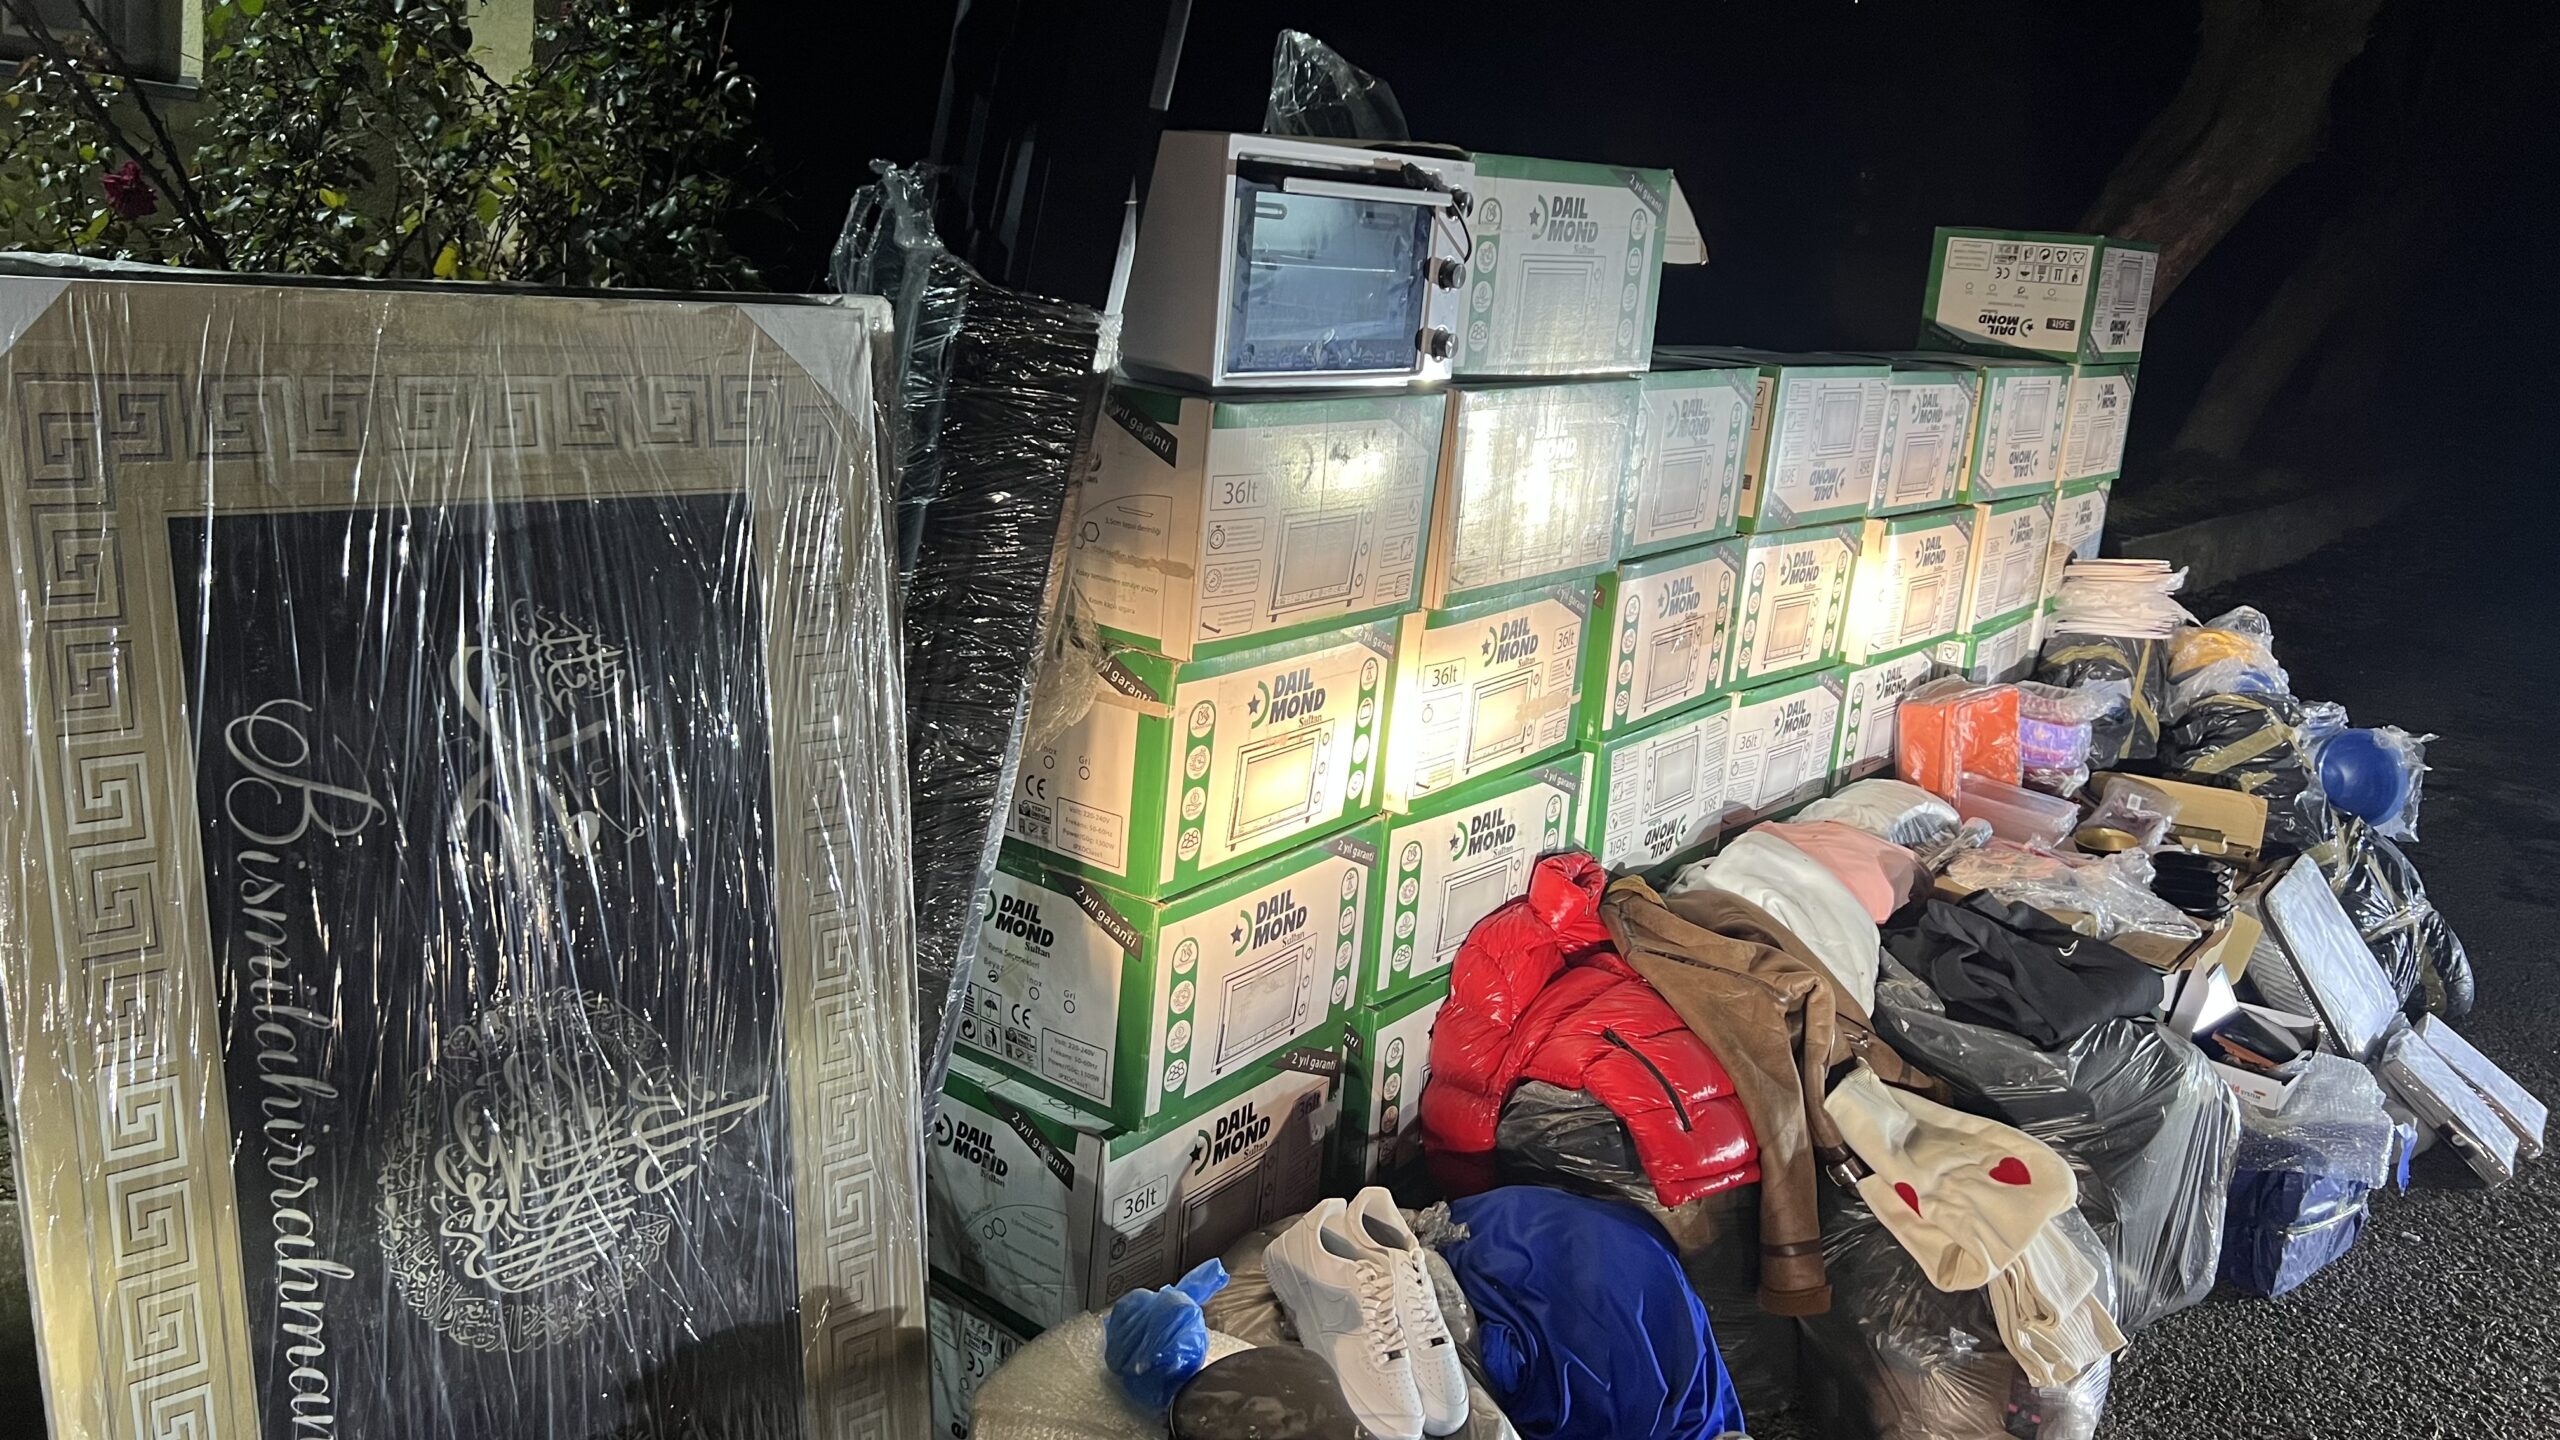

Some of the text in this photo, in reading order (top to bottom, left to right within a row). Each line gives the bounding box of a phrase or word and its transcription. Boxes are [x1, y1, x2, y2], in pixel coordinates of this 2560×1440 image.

[1551, 196, 1588, 219] DAIL
[1547, 221, 1599, 243] MOND
[1978, 315, 2020, 326] MOND
[1987, 325, 2017, 336] DAIL
[2052, 320, 2071, 330] 36lt
[1922, 394, 1939, 408] DAIL
[1114, 404, 1128, 424] yıl
[1920, 409, 1943, 424] MOND
[1809, 468, 1838, 486] MOND
[1222, 480, 1259, 505] 36lt
[1814, 486, 1833, 501] DAIL
[1925, 536, 1942, 551] DAIL
[1793, 550, 1815, 568] DAIL
[1922, 550, 1946, 567] MOND
[1671, 576, 1694, 597] DAIL
[1789, 566, 1819, 585] MOND
[1668, 592, 1700, 616] MOND
[1500, 617, 1530, 642] DAIL
[1557, 630, 1575, 651] 36lt
[1497, 635, 1539, 665] MOND
[1273, 667, 1314, 698] DAIL
[1432, 664, 1457, 688] 36lt
[1886, 666, 1902, 682] DAIL
[1884, 679, 1907, 698] MOND
[1269, 687, 1326, 724] MOND
[1787, 699, 1806, 719] DAIL
[1298, 714, 1323, 728] Sultan
[1783, 713, 1811, 735] MOND
[1739, 733, 1758, 750] 36lt
[1704, 795, 1718, 815] 36lt
[1470, 807, 1505, 836] DAIL
[1644, 819, 1678, 846] MOND
[1467, 823, 1516, 856] MOND
[1610, 836, 1627, 855] 36lt
[1650, 836, 1674, 860] DAIL
[1337, 840, 1375, 862] 2 yıl garanti
[1000, 894, 1042, 925] DAIL
[1075, 886, 1137, 948] 2 yıl garanti
[1255, 889, 1295, 925] DAIL
[995, 912, 1054, 948] MOND
[1252, 906, 1307, 950] MOND
[1024, 941, 1051, 959] Sultan
[1281, 931, 1305, 948] Sultan
[1064, 990, 1076, 1001] Gri
[1011, 1003, 1031, 1029] CE
[1291, 1053, 1337, 1070] 2 yıl garanti
[1011, 1112, 1020, 1123] 2
[1018, 1122, 1033, 1138] yıl
[1215, 1102, 1257, 1139] DAIL
[956, 1120, 996, 1154] DAIL
[1212, 1116, 1271, 1166] MOND
[953, 1138, 1008, 1177] MOND
[1243, 1140, 1268, 1161] Sultan
[1123, 1188, 1157, 1219] 36lt
